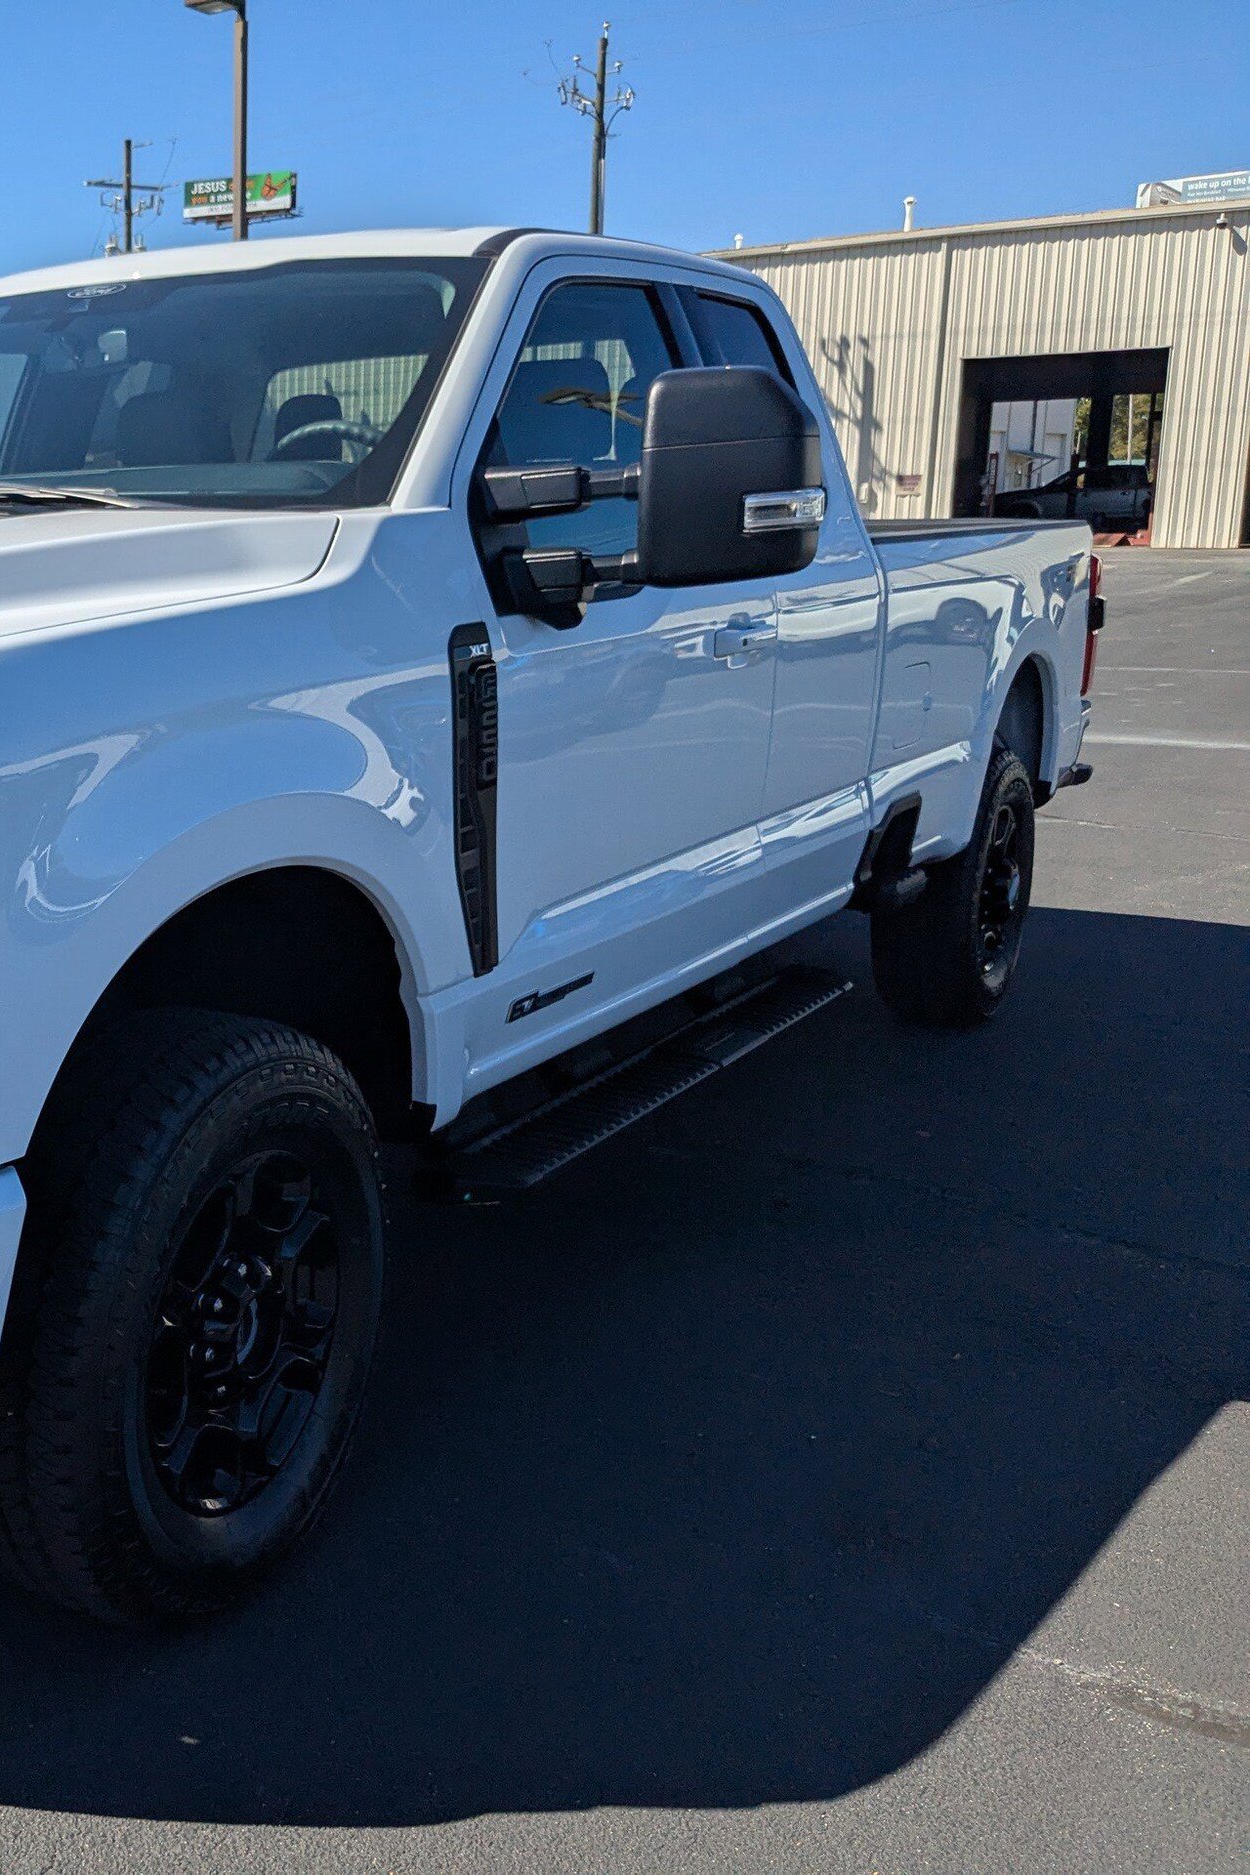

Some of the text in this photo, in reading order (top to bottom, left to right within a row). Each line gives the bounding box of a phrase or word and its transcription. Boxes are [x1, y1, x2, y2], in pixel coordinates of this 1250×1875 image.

[191, 180, 227, 195] JESUS
[1187, 181, 1207, 191] wake
[1209, 182, 1219, 190] up
[1221, 180, 1231, 188] on
[1233, 177, 1246, 186] the
[469, 643, 489, 658] XLT
